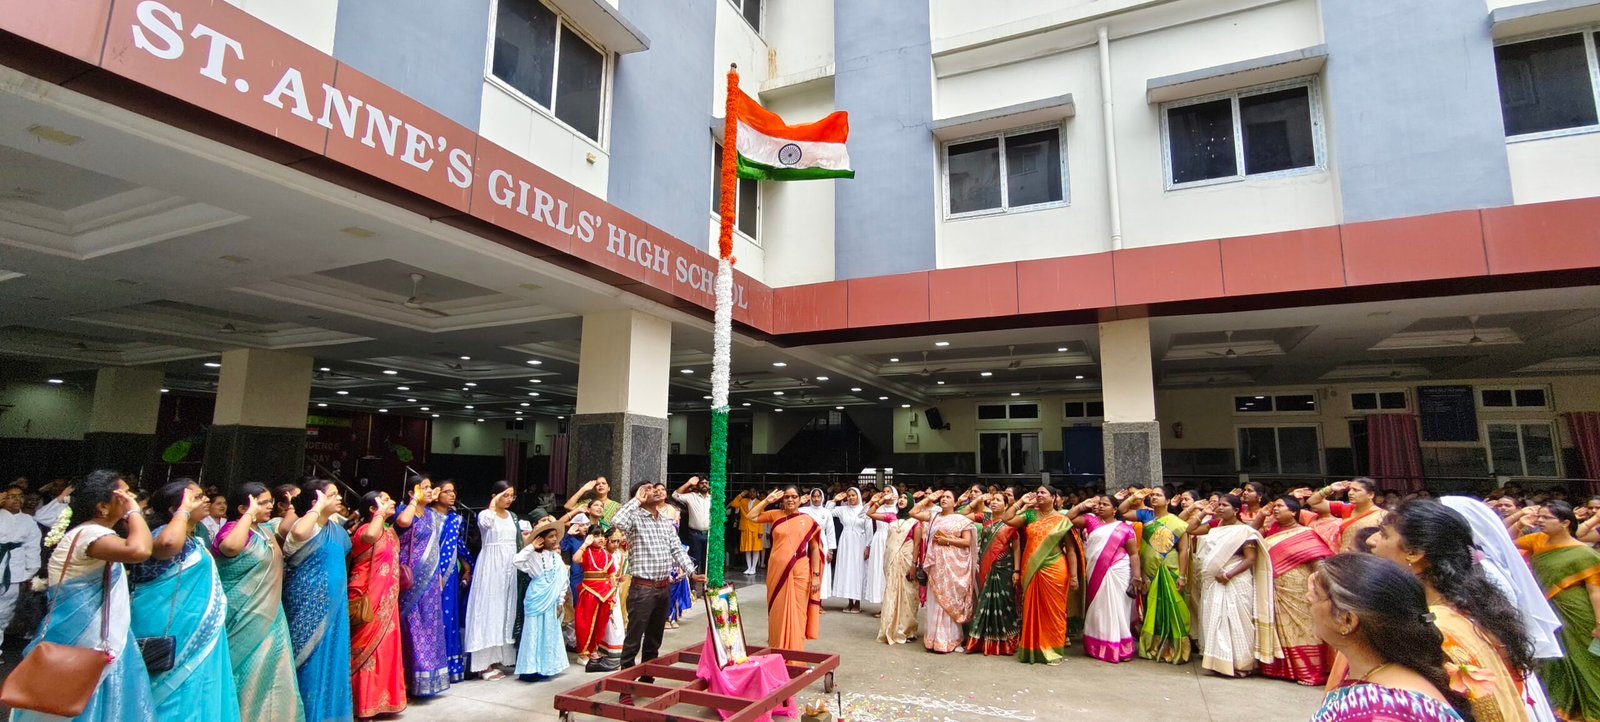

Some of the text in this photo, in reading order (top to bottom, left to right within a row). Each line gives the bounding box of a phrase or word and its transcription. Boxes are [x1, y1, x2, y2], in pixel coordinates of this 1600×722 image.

[131, 0, 748, 310] ST. ANNE'S GIRLS' HIGH SCHL
